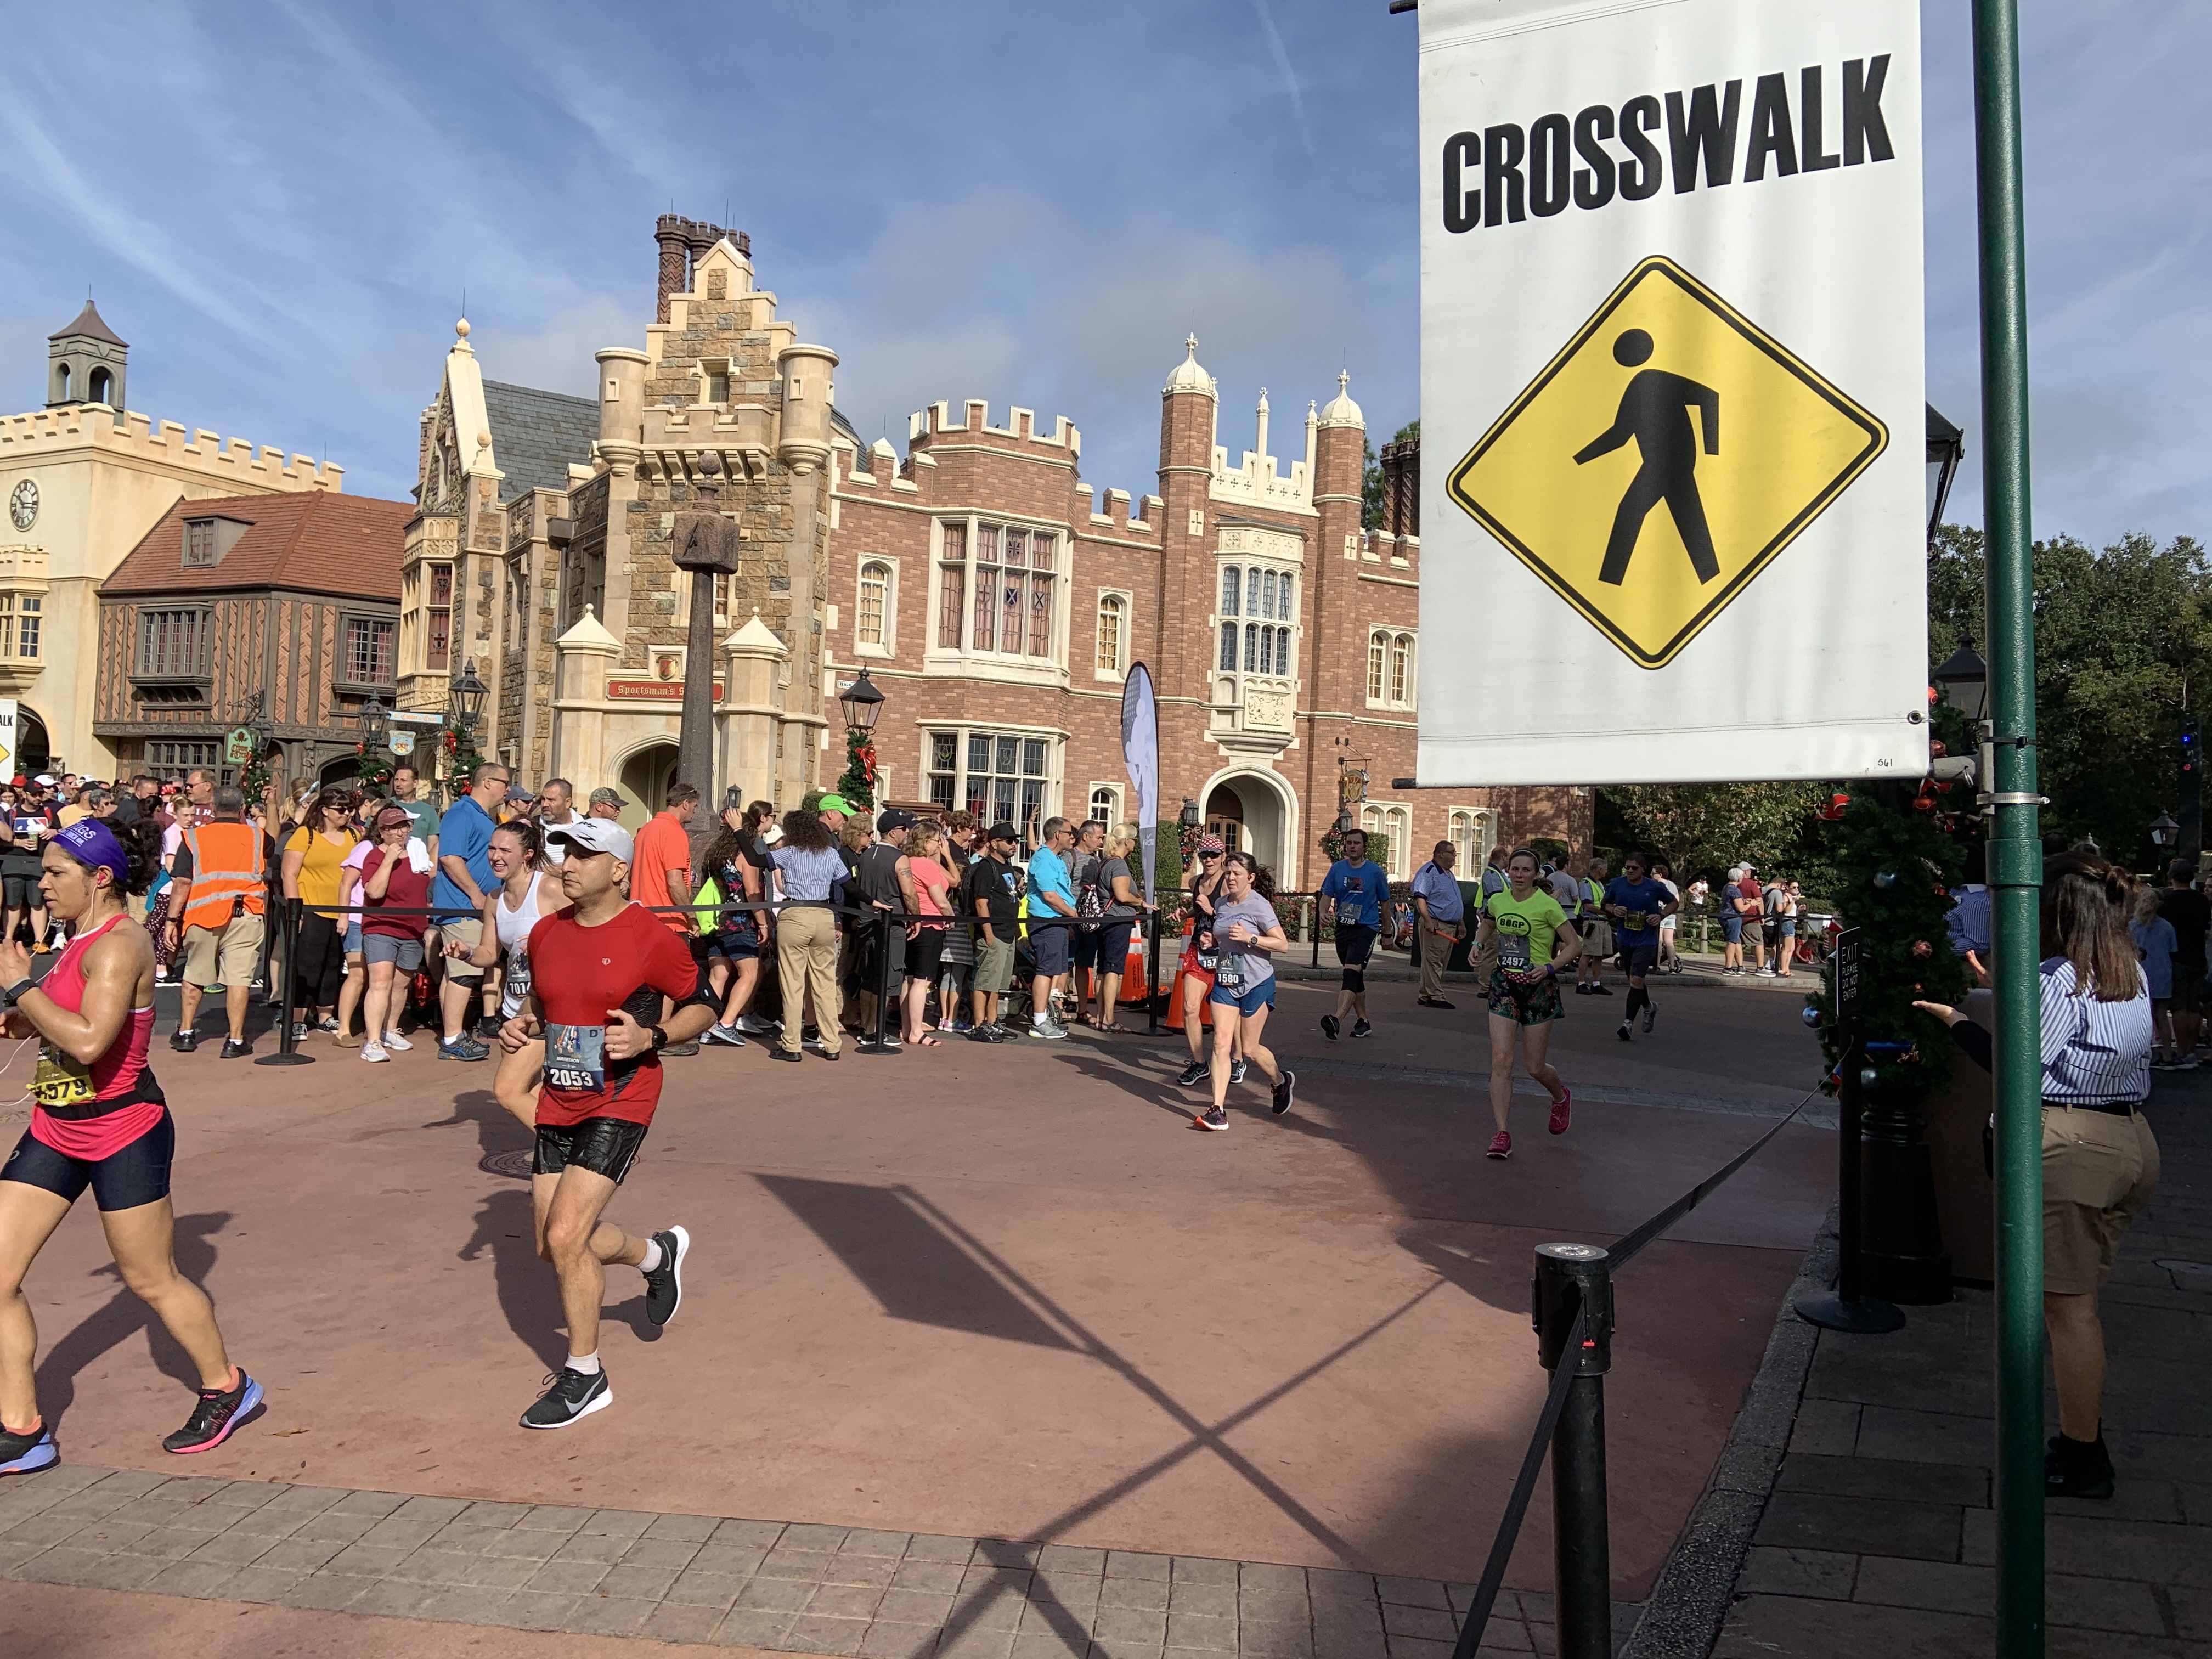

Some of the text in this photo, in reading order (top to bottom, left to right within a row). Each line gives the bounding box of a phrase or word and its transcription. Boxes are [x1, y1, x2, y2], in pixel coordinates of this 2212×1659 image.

[1443, 54, 1895, 234] CROSSWALK
[618, 685, 675, 696] Sportsman's
[1500, 918, 1525, 928] BOGP
[1842, 943, 1858, 964] EXIT
[1203, 958, 1217, 967] 157
[1502, 956, 1524, 966] 2497
[1842, 962, 1858, 976] PLEASE
[1218, 973, 1239, 983] 1580
[1842, 978, 1848, 989] DO
[1843, 988, 1857, 1001] ENTER
[589, 1029, 598, 1037] D
[550, 1069, 593, 1086] 2053
